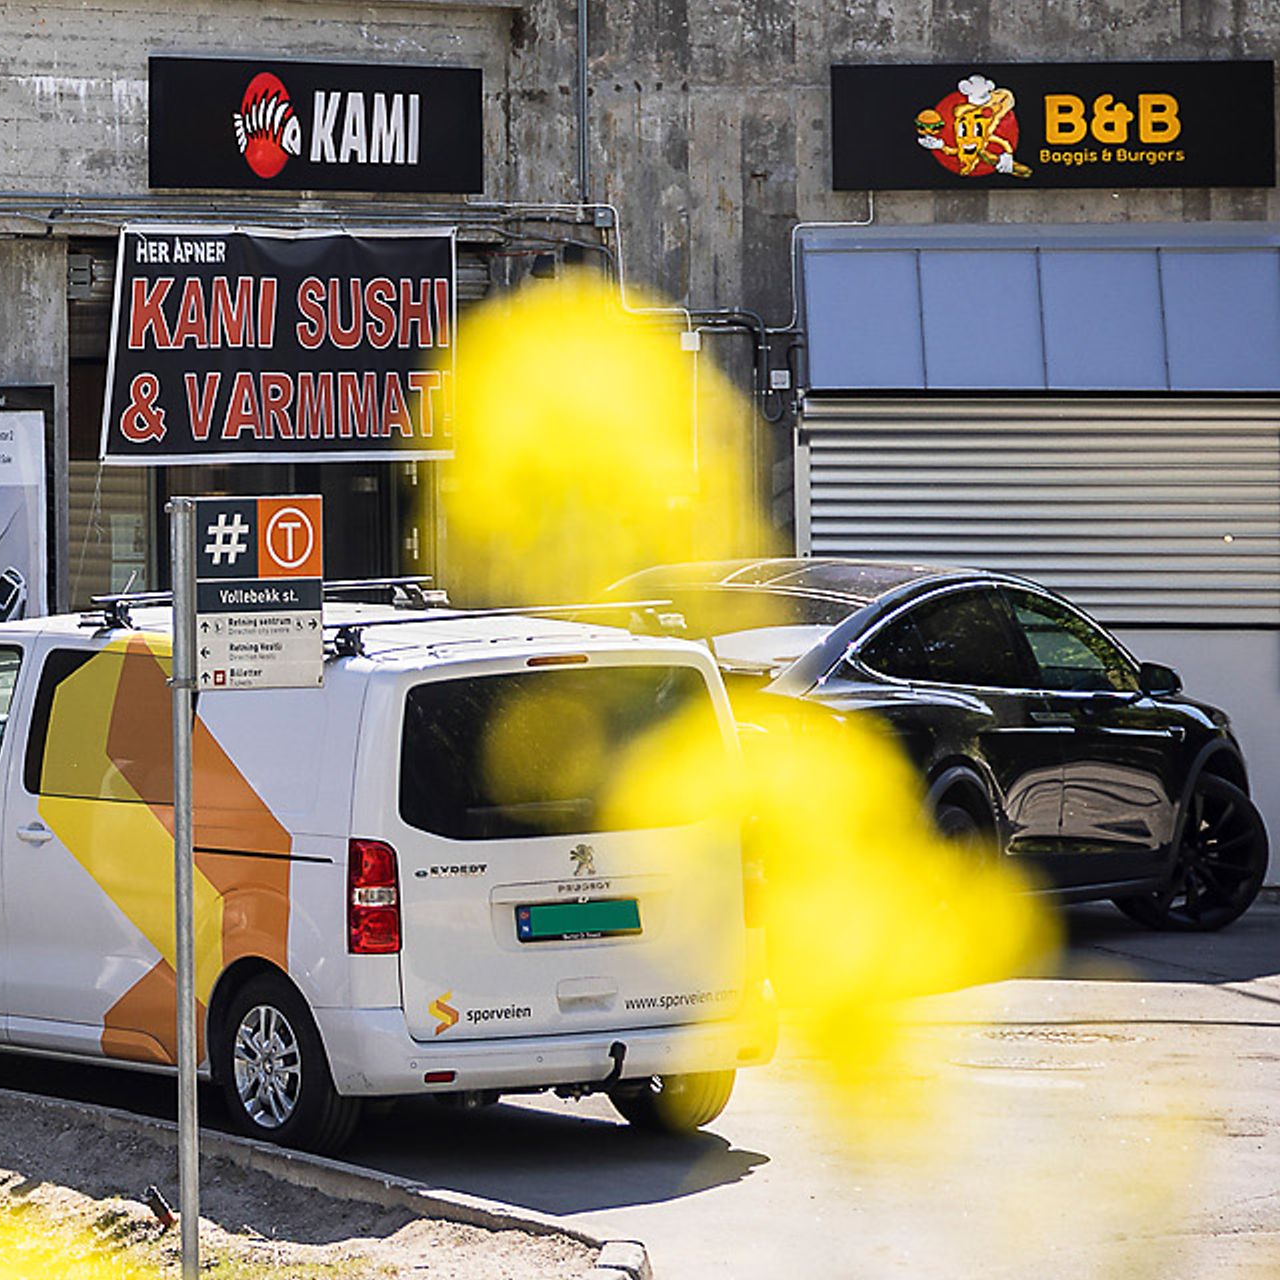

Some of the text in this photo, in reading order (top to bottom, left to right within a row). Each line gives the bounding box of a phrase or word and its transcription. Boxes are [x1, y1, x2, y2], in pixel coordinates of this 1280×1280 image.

[309, 90, 420, 165] KAMI
[1043, 93, 1182, 145] B&B
[1101, 148, 1113, 163] &
[1116, 148, 1186, 166] Burgers
[135, 239, 171, 264] HER
[127, 276, 450, 350] KAMI SUSHI
[119, 372, 168, 443] &
[219, 588, 281, 604] Vollebekk
[466, 1004, 532, 1025] sporveien
